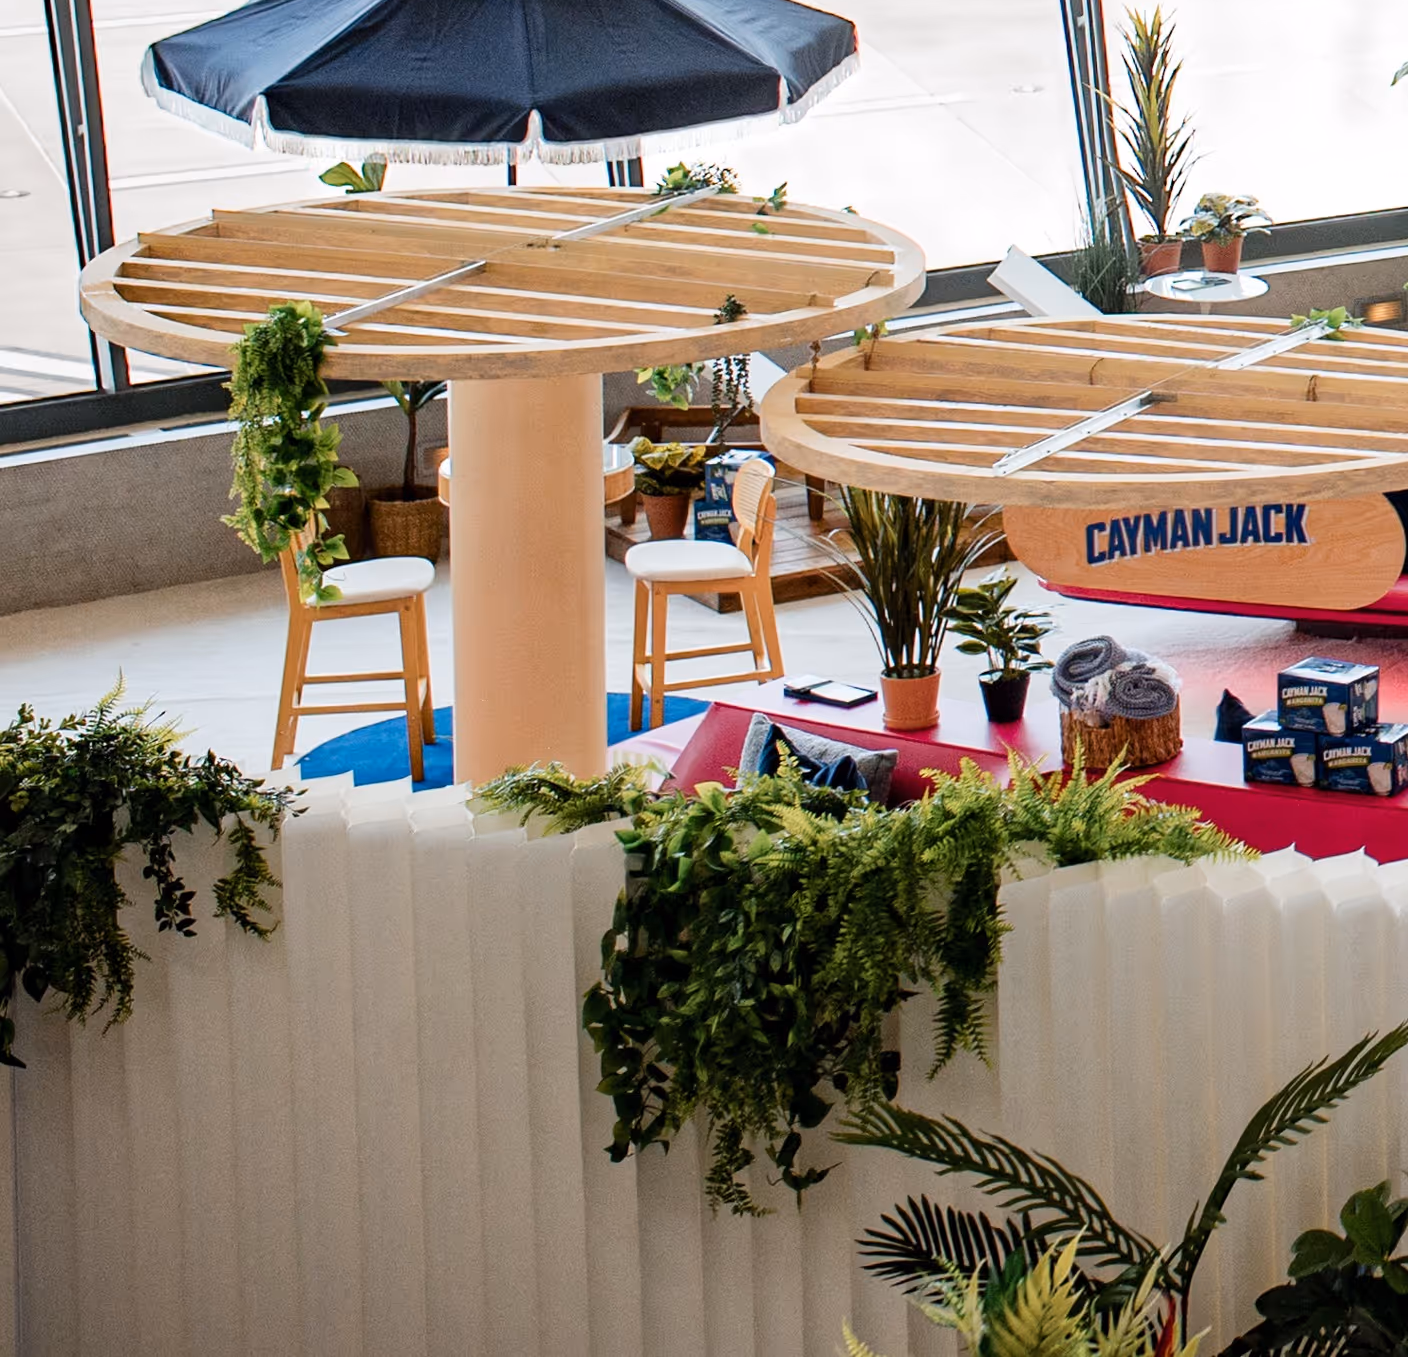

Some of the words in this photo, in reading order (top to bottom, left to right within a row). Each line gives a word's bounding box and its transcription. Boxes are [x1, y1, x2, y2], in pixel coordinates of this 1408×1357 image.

[1085, 508, 1217, 566] CAYMAN
[1218, 503, 1312, 545] JACK
[1282, 686, 1310, 699] CAYMAN
[1309, 686, 1328, 697] JACK
[1247, 738, 1276, 752] CAYMAN
[1276, 738, 1295, 748] JACK
[1323, 747, 1352, 761] CAYMAN
[1351, 746, 1372, 756] JACK
